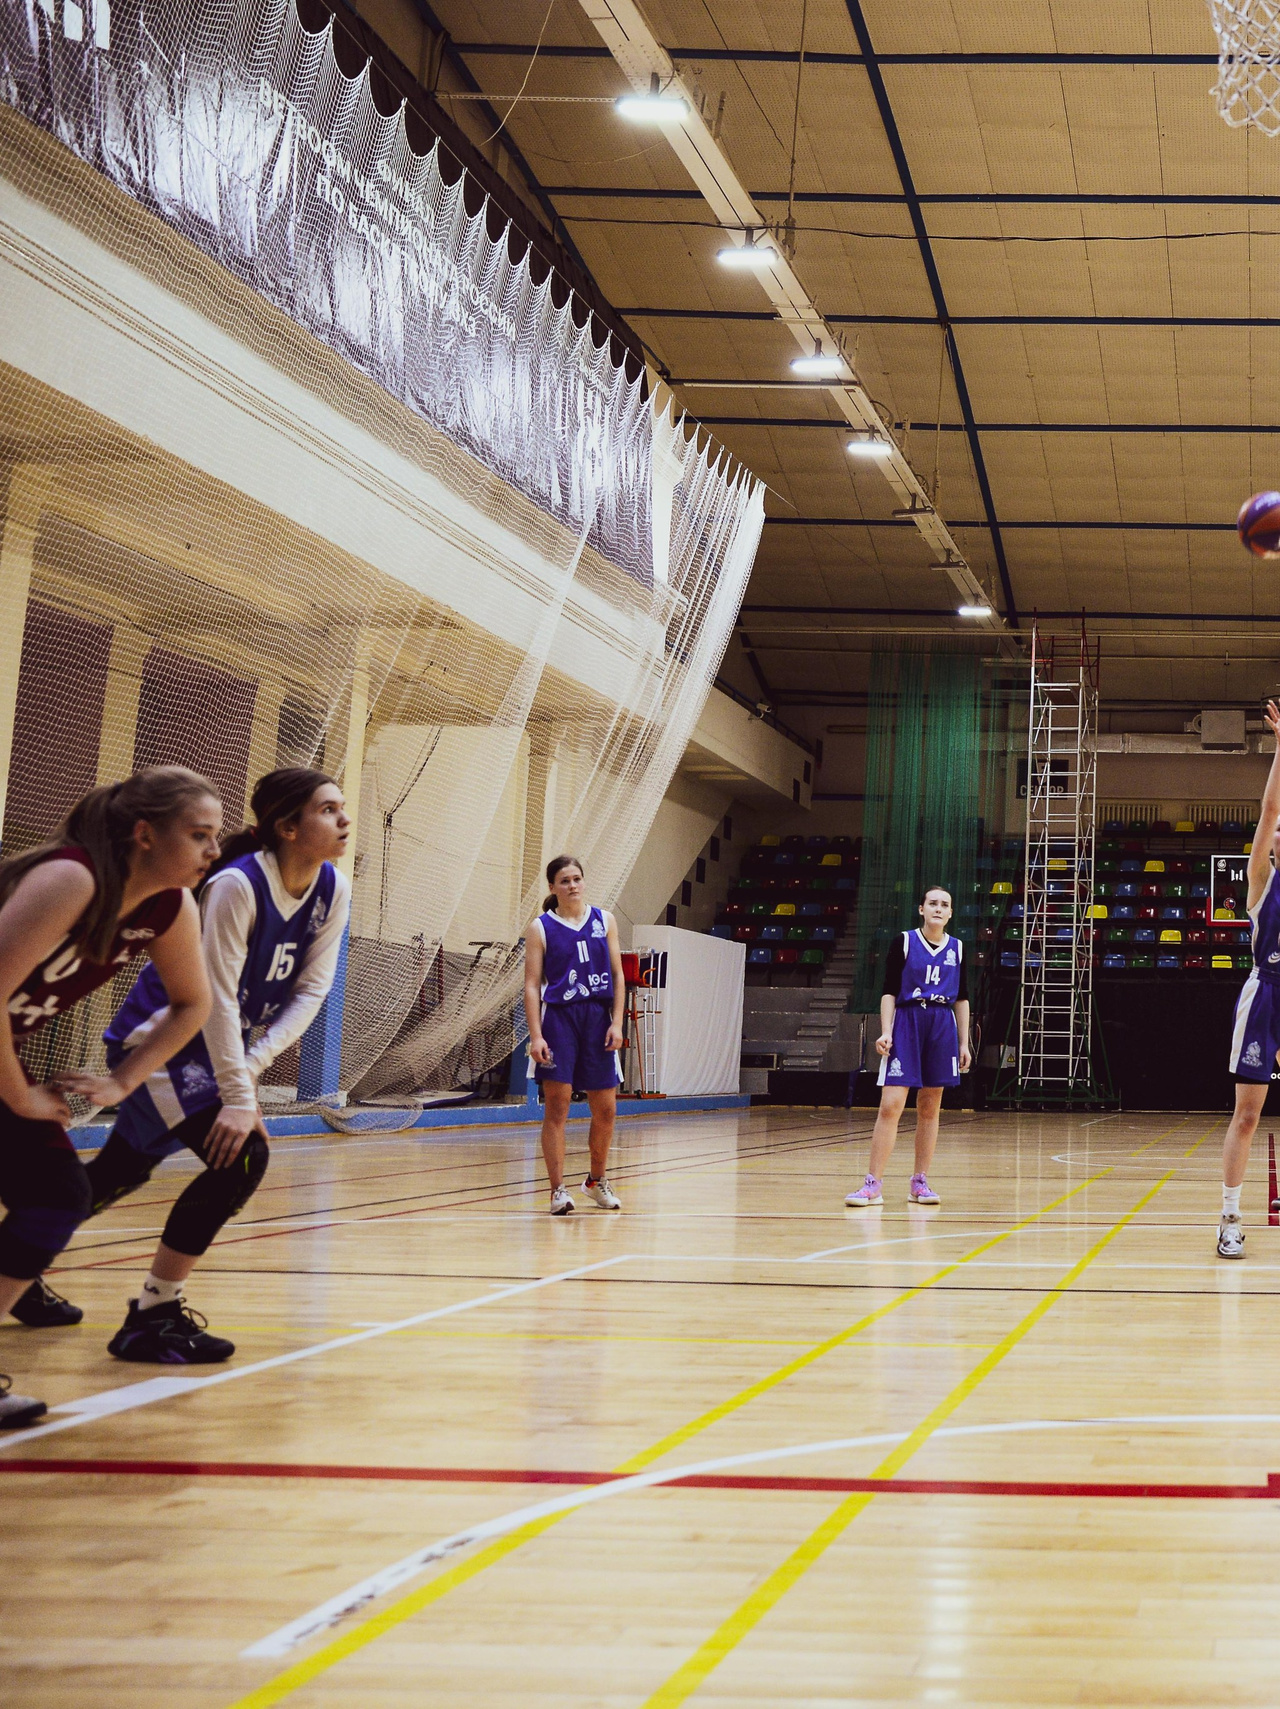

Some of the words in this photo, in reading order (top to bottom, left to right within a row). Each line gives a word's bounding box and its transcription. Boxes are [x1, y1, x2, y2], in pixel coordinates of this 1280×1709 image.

[316, 171, 344, 216] ПО
[266, 942, 297, 981] 15
[577, 940, 590, 963] 11
[925, 964, 940, 985] 14
